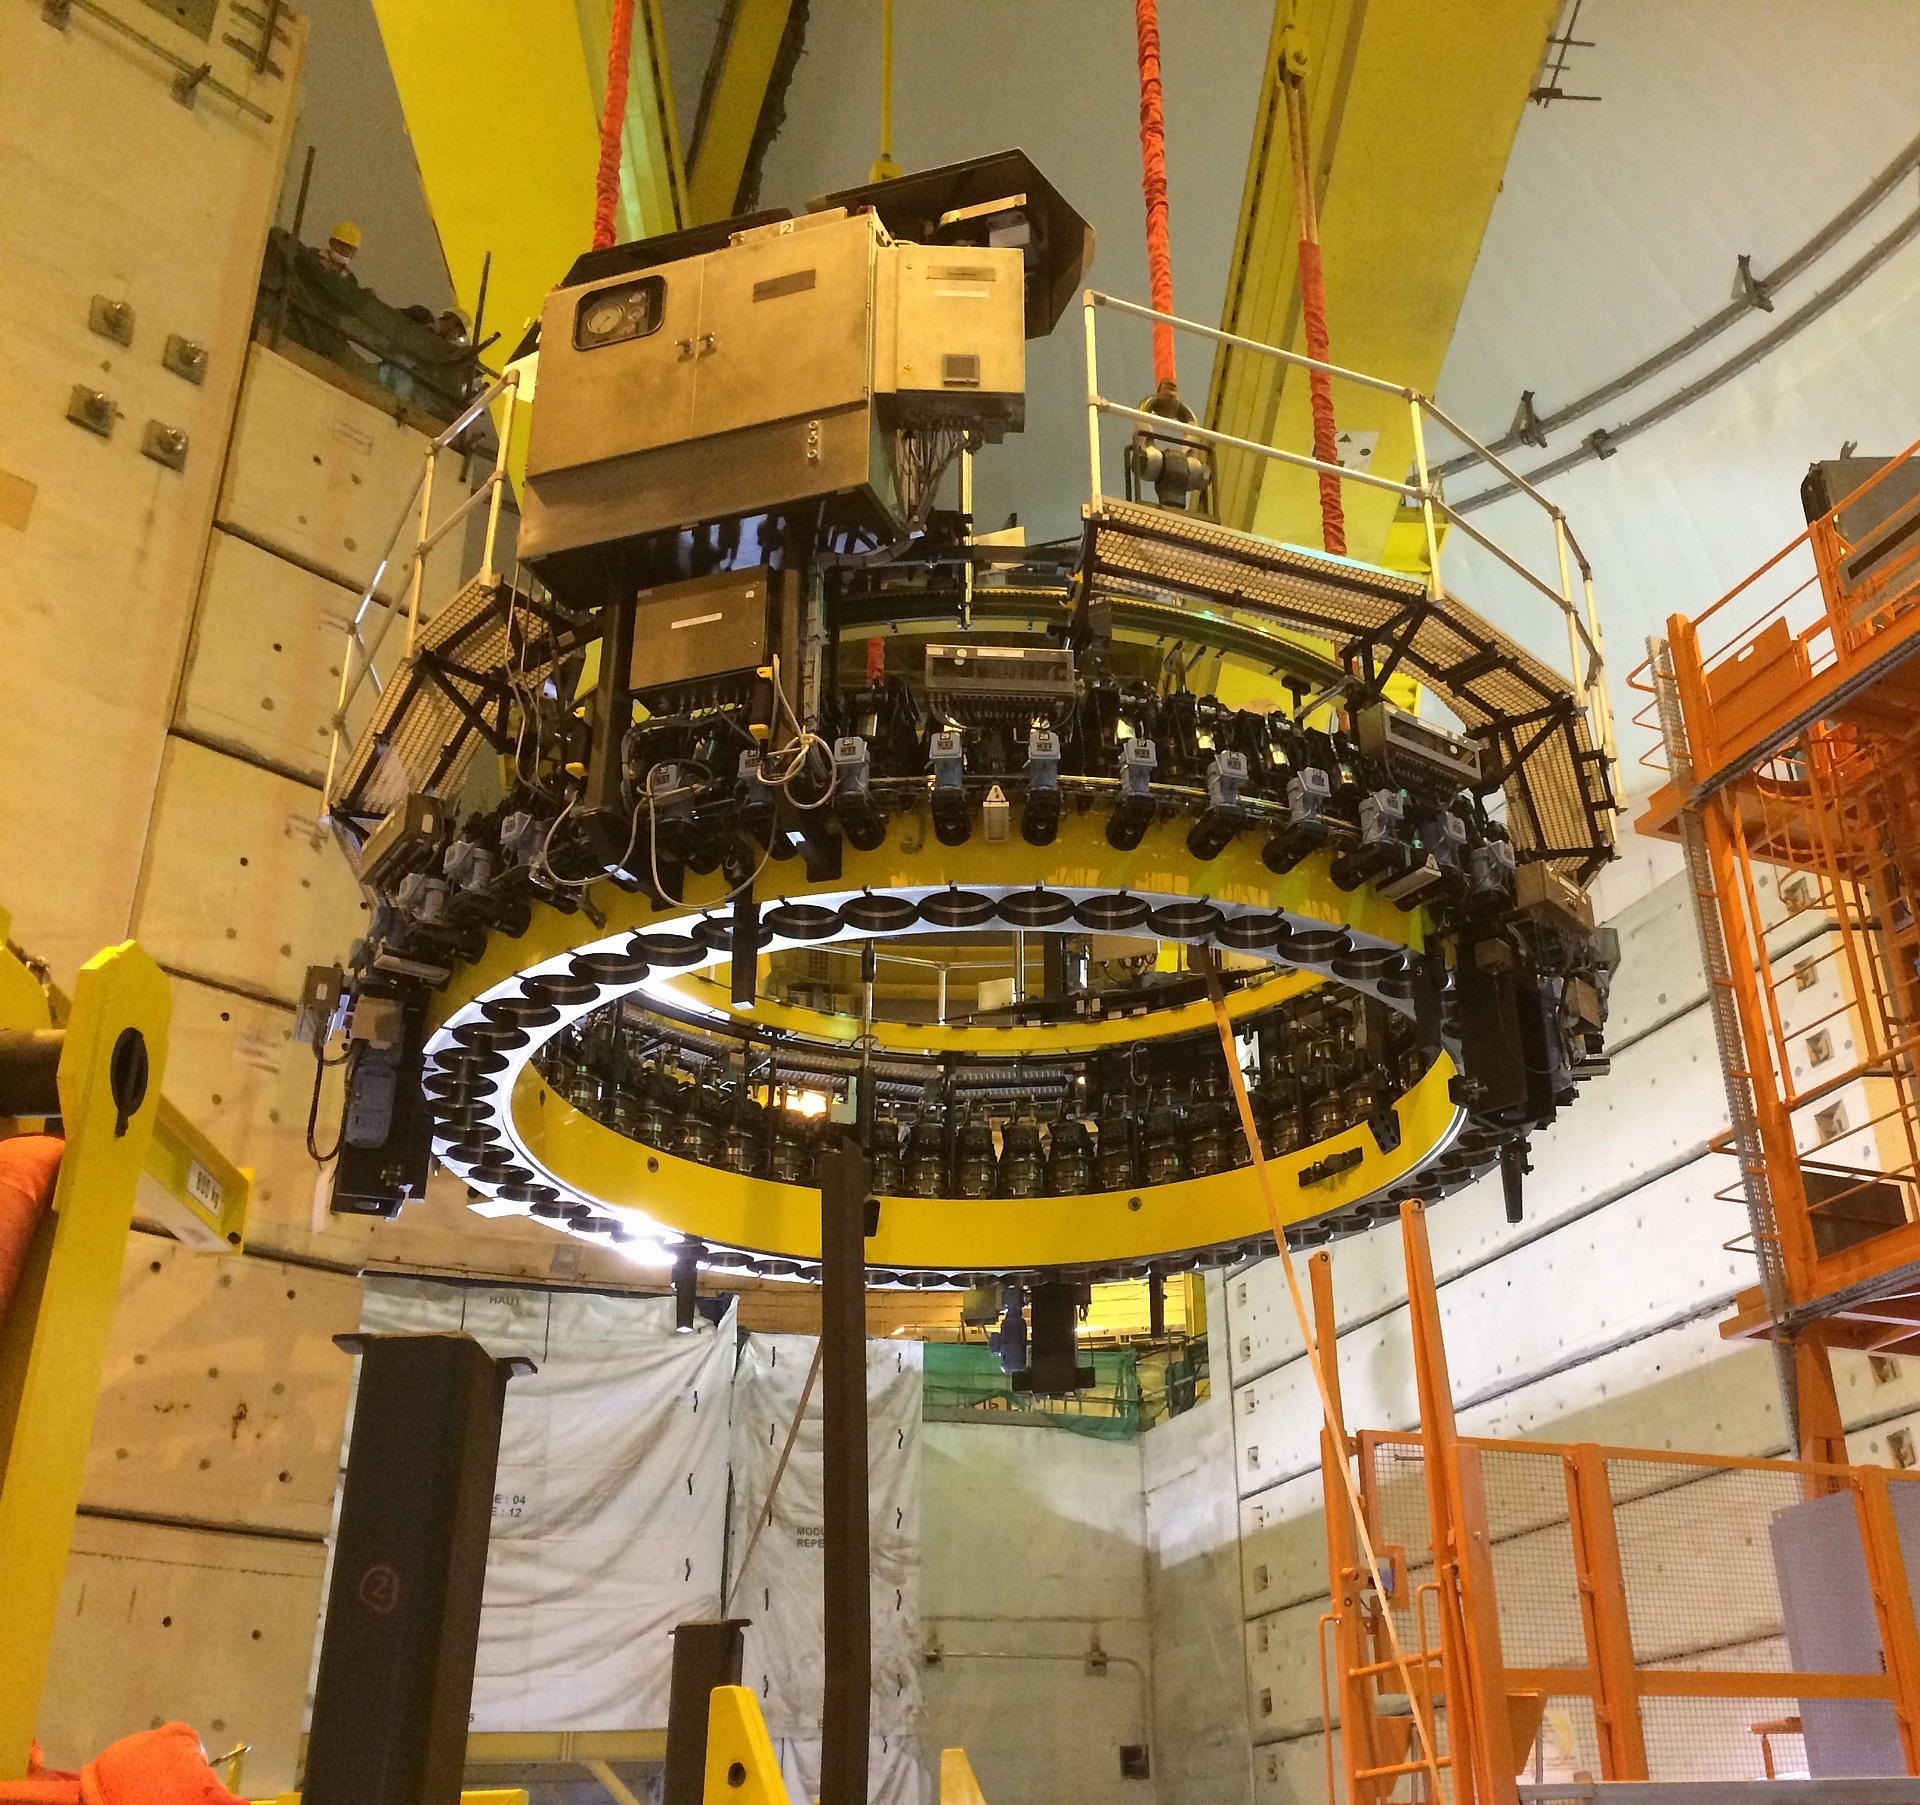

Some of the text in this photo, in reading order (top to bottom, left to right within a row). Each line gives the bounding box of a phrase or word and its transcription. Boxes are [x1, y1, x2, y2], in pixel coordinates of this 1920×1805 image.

[782, 223, 792, 235] 2
[1416, 966, 1423, 976] 3
[1509, 1152, 1516, 1160] 2
[196, 1171, 220, 1209] 800 kg
[489, 1296, 519, 1306] HAUT
[512, 1494, 526, 1505] 04
[509, 1507, 522, 1518] 12
